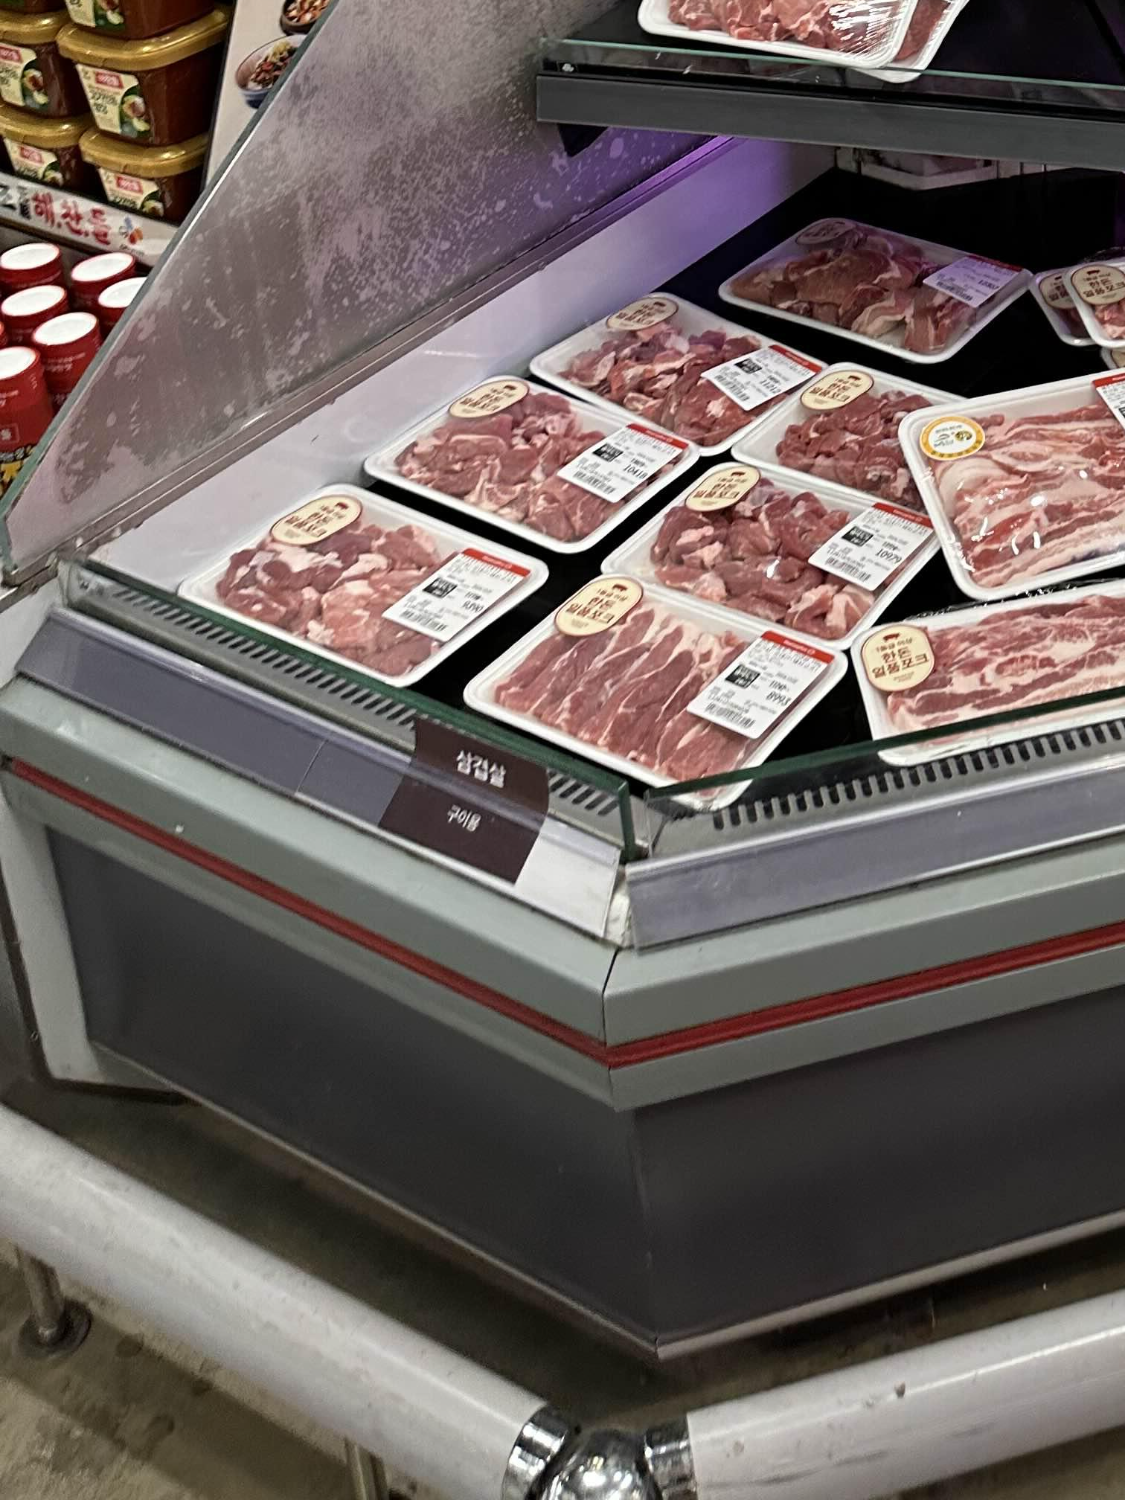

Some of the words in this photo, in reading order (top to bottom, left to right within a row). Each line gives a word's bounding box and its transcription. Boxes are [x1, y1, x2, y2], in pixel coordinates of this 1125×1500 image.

[31, 192, 111, 246] 해찬들
[456, 750, 506, 788] 삼겹살
[447, 804, 481, 832] 구이용
